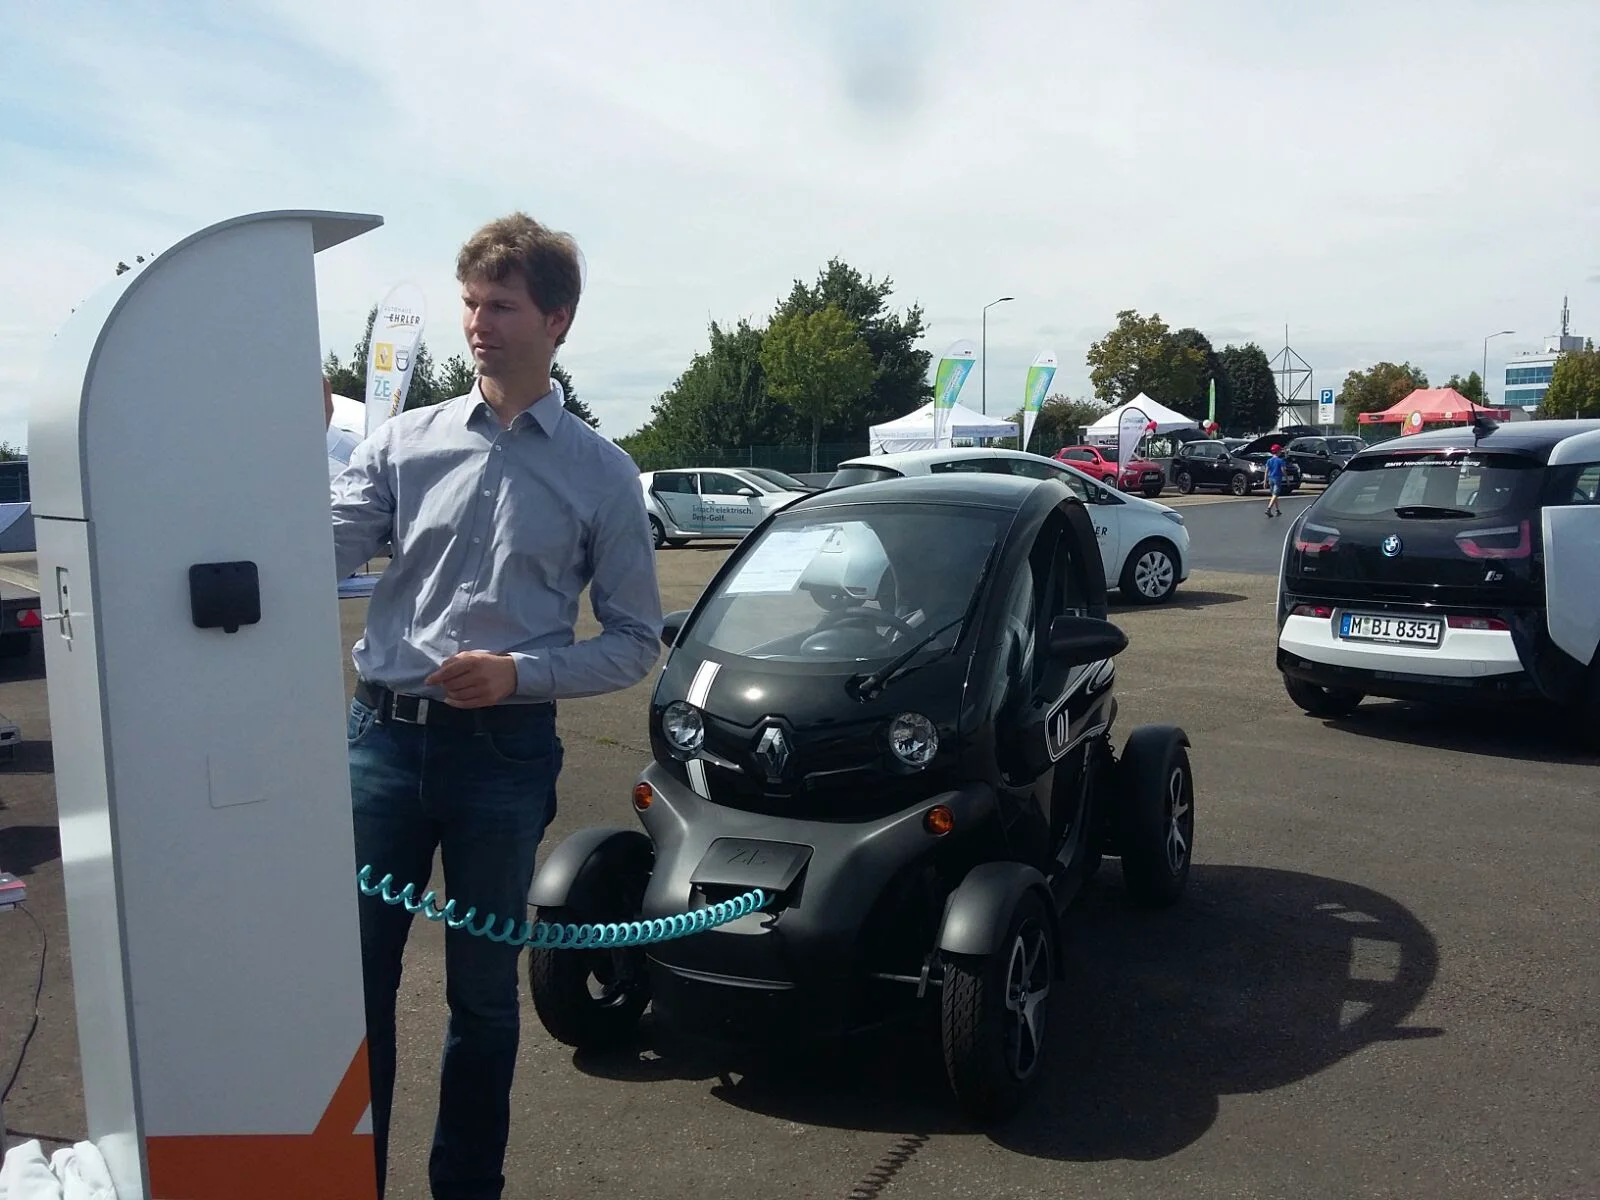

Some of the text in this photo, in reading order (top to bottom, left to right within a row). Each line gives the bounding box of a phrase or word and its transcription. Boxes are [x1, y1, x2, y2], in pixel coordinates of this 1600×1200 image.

[387, 313, 421, 325] EHRLER
[1323, 391, 1331, 403] P
[1351, 616, 1437, 641] M BI 8351
[1056, 708, 1069, 747] 01
